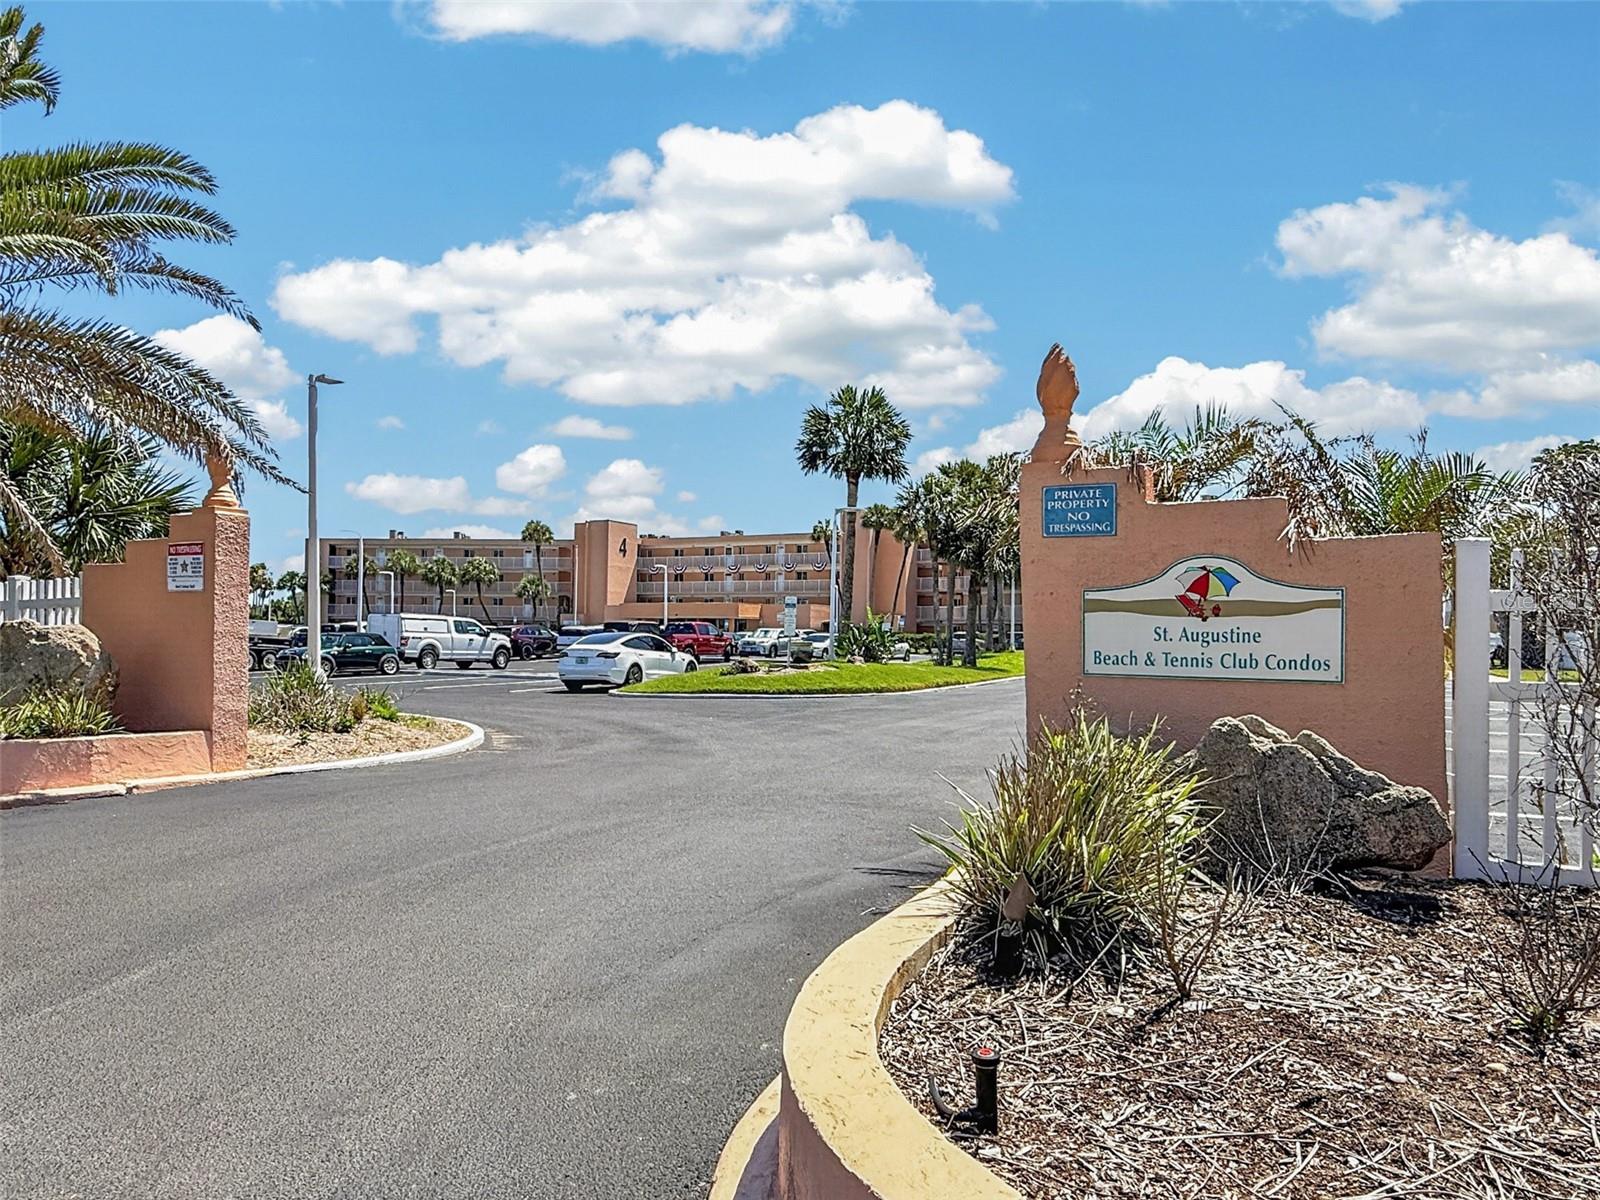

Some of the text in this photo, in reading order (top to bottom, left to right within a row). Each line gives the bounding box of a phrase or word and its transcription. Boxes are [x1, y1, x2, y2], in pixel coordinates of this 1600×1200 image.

[1054, 488, 1103, 500] PRIVATE
[1047, 498, 1110, 510] PROPERTY
[1067, 511, 1091, 522] NO
[1048, 521, 1111, 533] TRESPASSING
[619, 537, 628, 558] 4
[1153, 625, 1262, 648] St. Augustine
[1093, 649, 1331, 672] Beach & Tennis Club Condos
